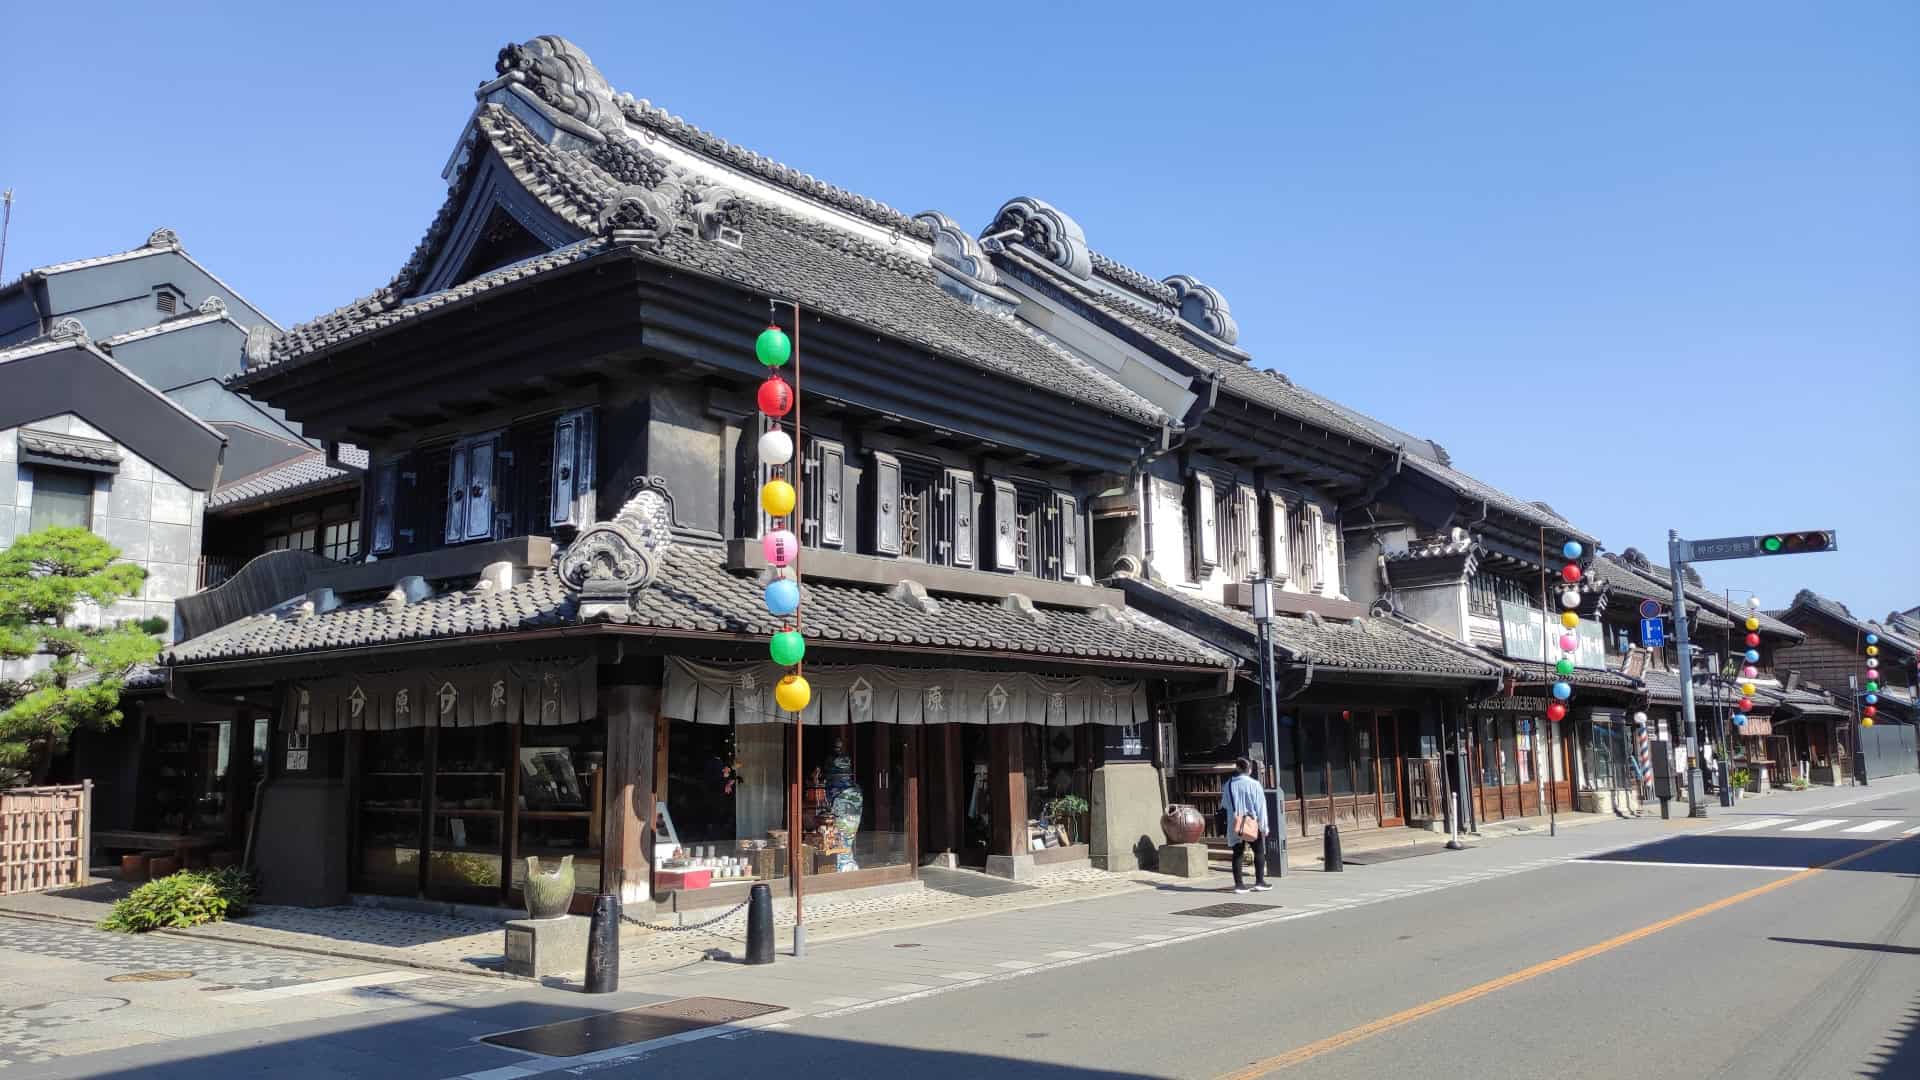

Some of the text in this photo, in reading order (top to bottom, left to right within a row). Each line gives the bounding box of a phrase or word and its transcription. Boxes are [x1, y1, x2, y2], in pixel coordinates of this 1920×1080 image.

[395, 688, 409, 713] 原
[490, 680, 506, 707] 原
[927, 685, 944, 711] 原
